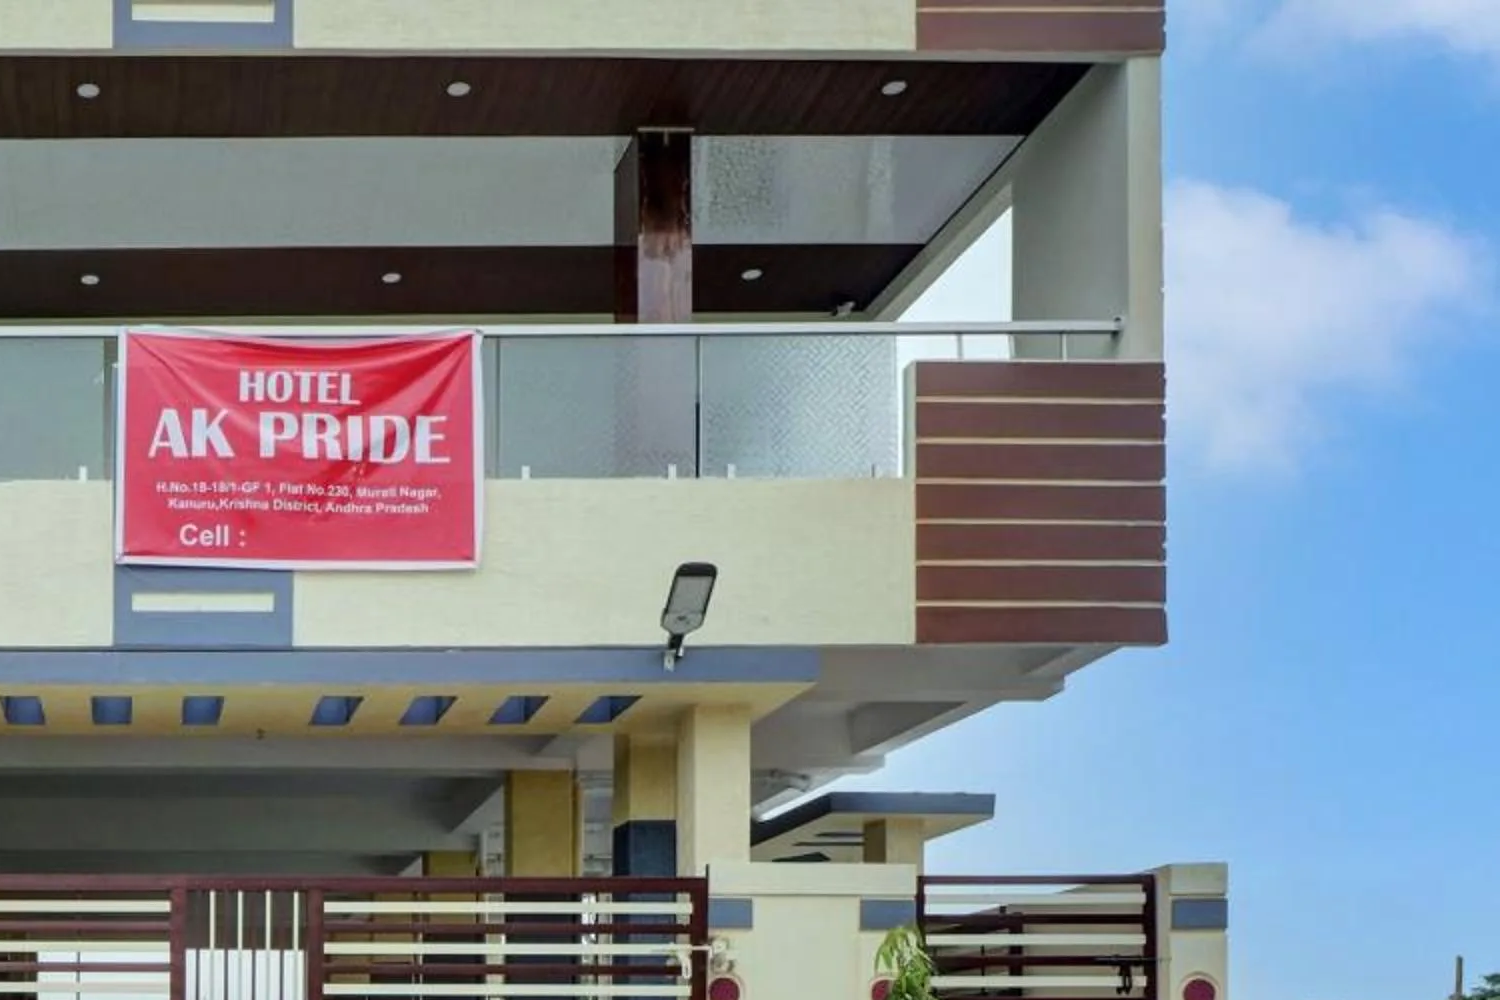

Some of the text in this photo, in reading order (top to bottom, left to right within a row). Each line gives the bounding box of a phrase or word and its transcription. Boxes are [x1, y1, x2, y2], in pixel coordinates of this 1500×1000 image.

[240, 370, 361, 405] HOTEL
[148, 408, 451, 464] AK PRIDE
[400, 487, 441, 501] Nagar,
[273, 499, 321, 513] District,
[325, 501, 372, 513] Andhra
[376, 502, 429, 513] Pradesh
[180, 524, 229, 547] Cell
